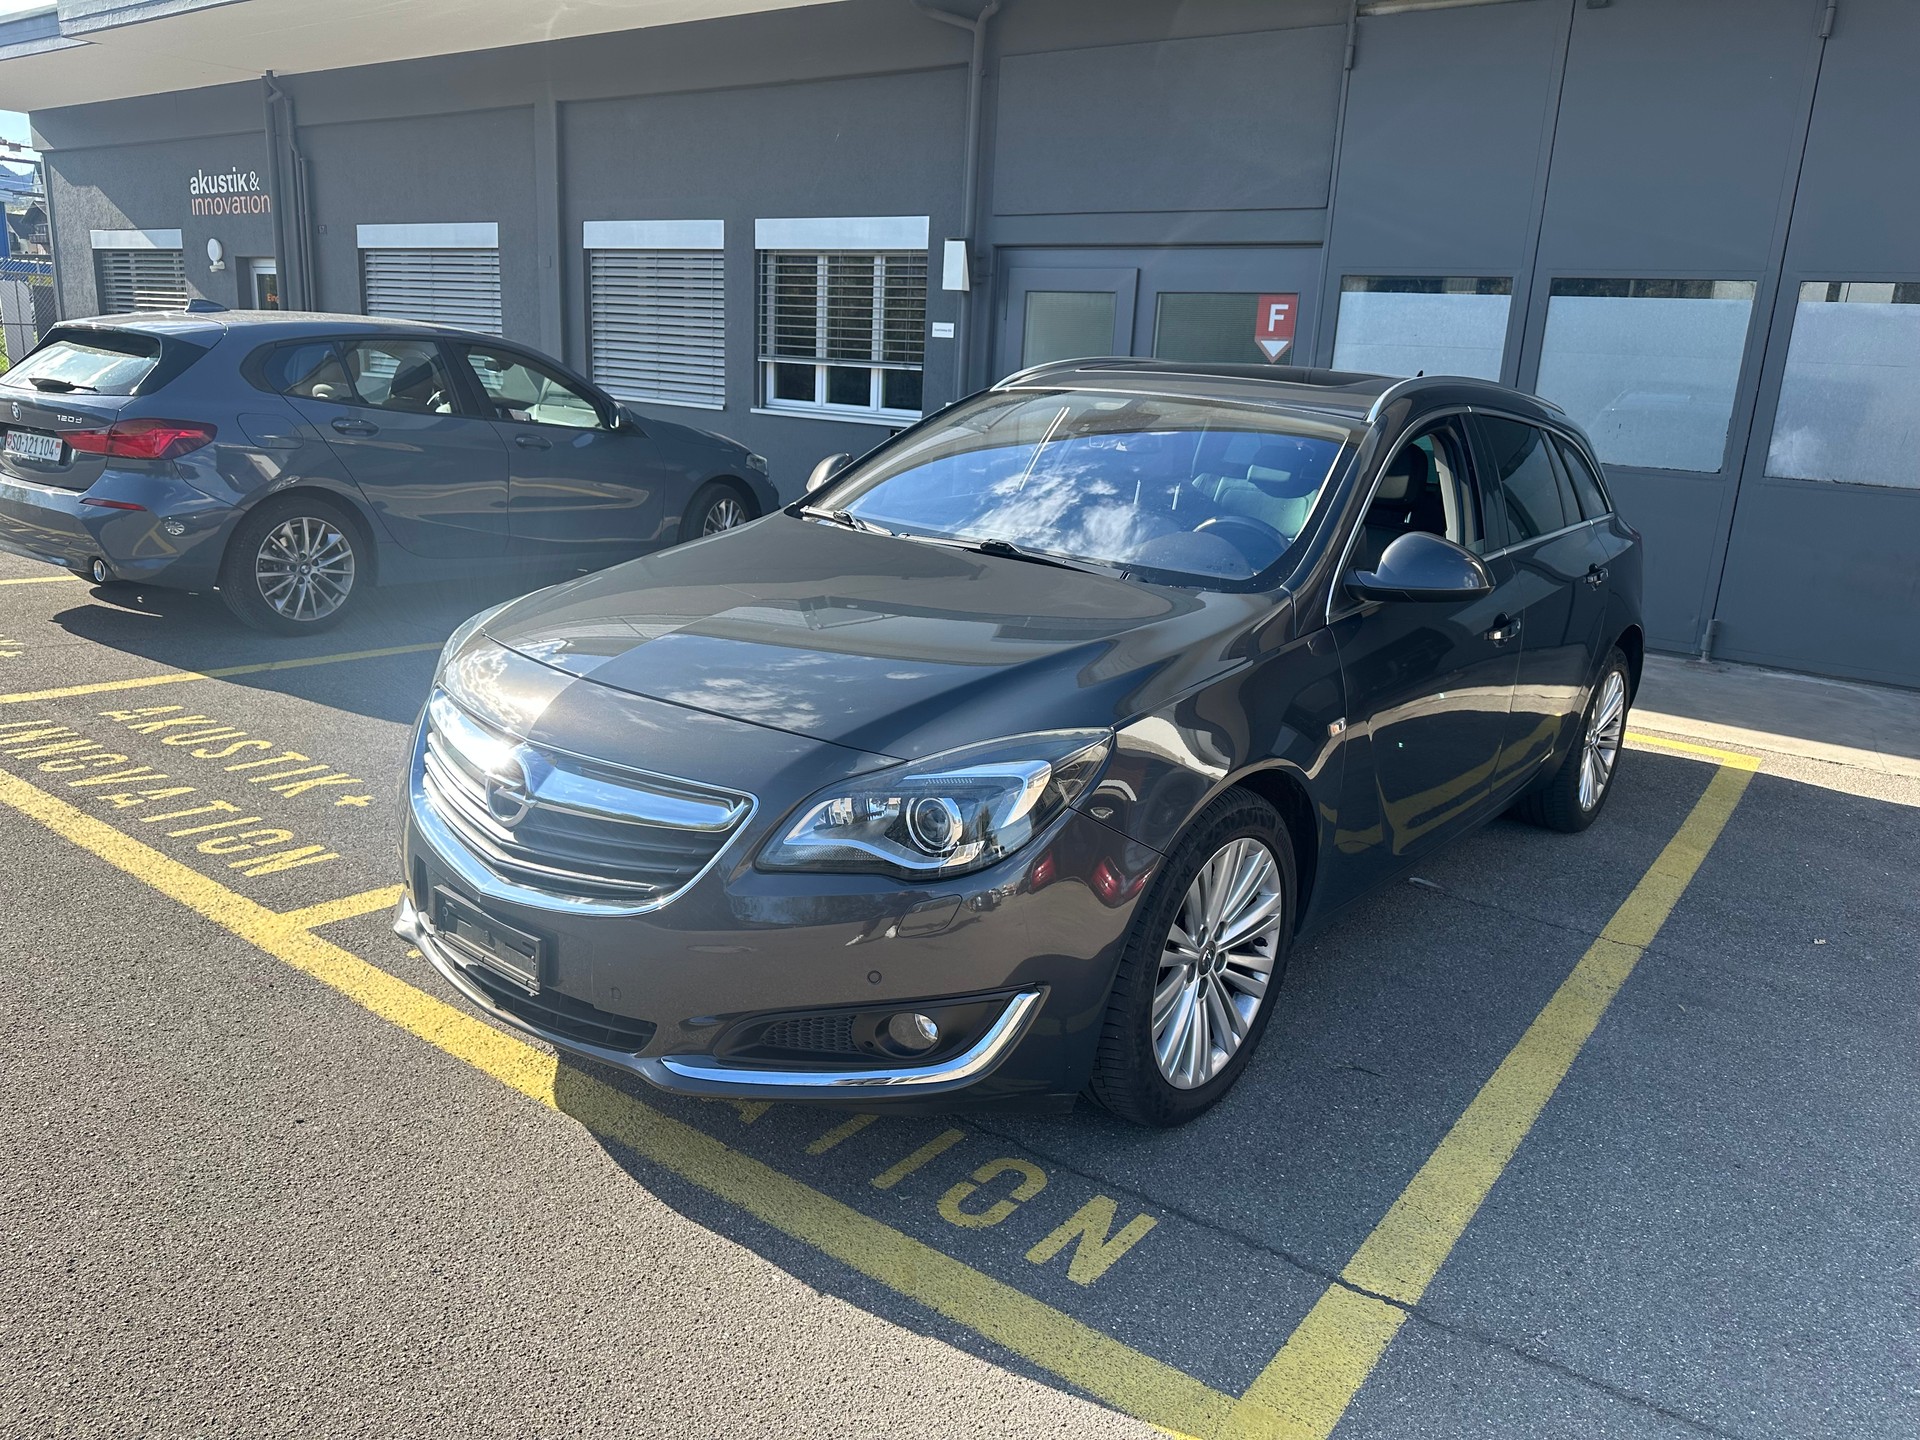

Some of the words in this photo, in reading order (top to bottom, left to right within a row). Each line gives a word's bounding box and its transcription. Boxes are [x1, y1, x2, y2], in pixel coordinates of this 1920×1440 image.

[191, 194, 271, 216] innovation
[1268, 303, 1289, 333] F
[99, 705, 364, 799] AKUSTIK
